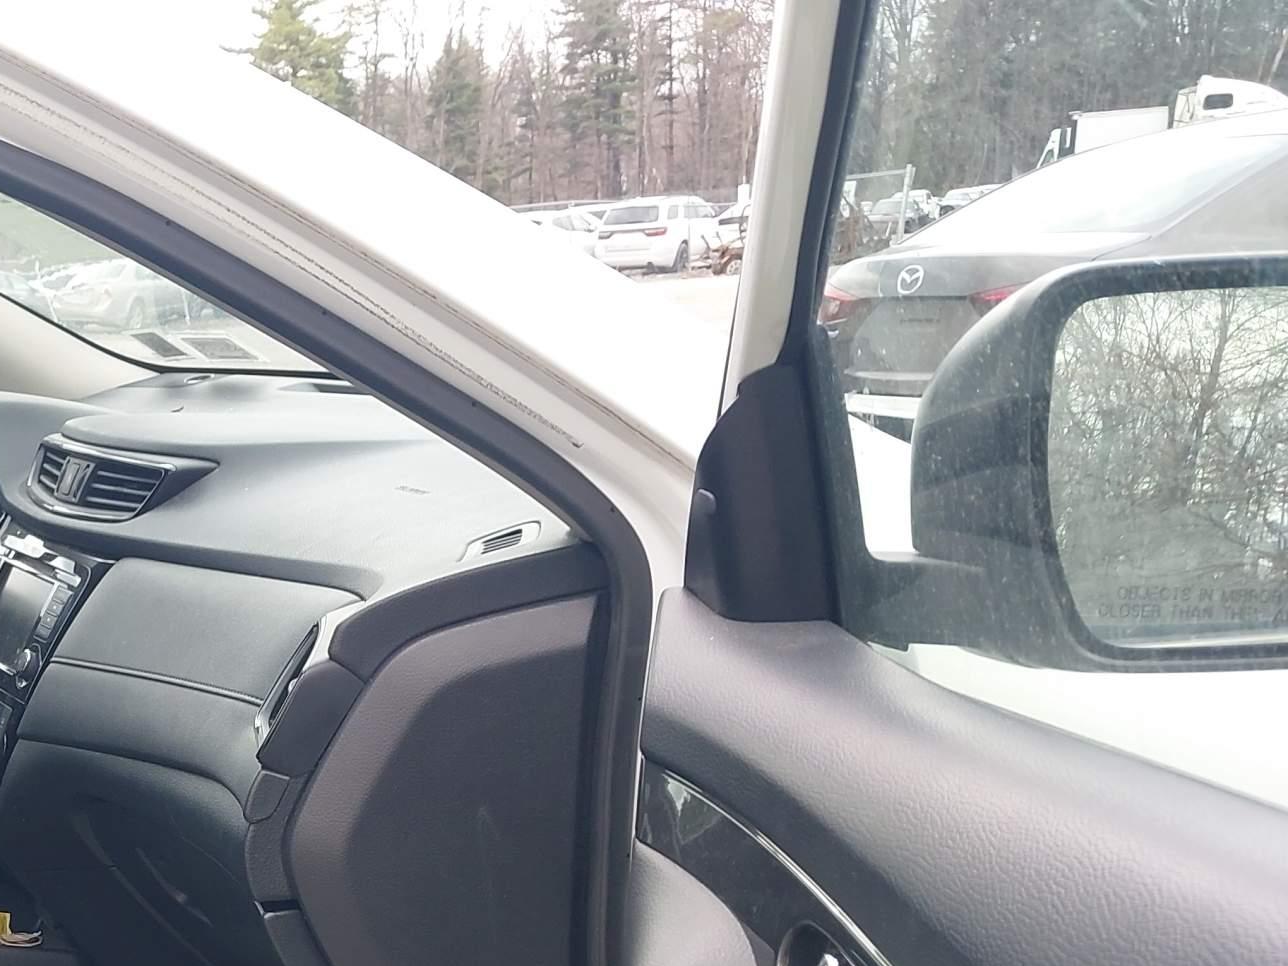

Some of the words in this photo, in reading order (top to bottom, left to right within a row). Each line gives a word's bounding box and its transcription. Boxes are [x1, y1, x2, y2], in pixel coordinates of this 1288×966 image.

[1117, 585, 1191, 602] OBJECTS
[1199, 587, 1213, 602] IN
[1098, 603, 1161, 619] CLOSER
[1170, 604, 1212, 621] THAN
